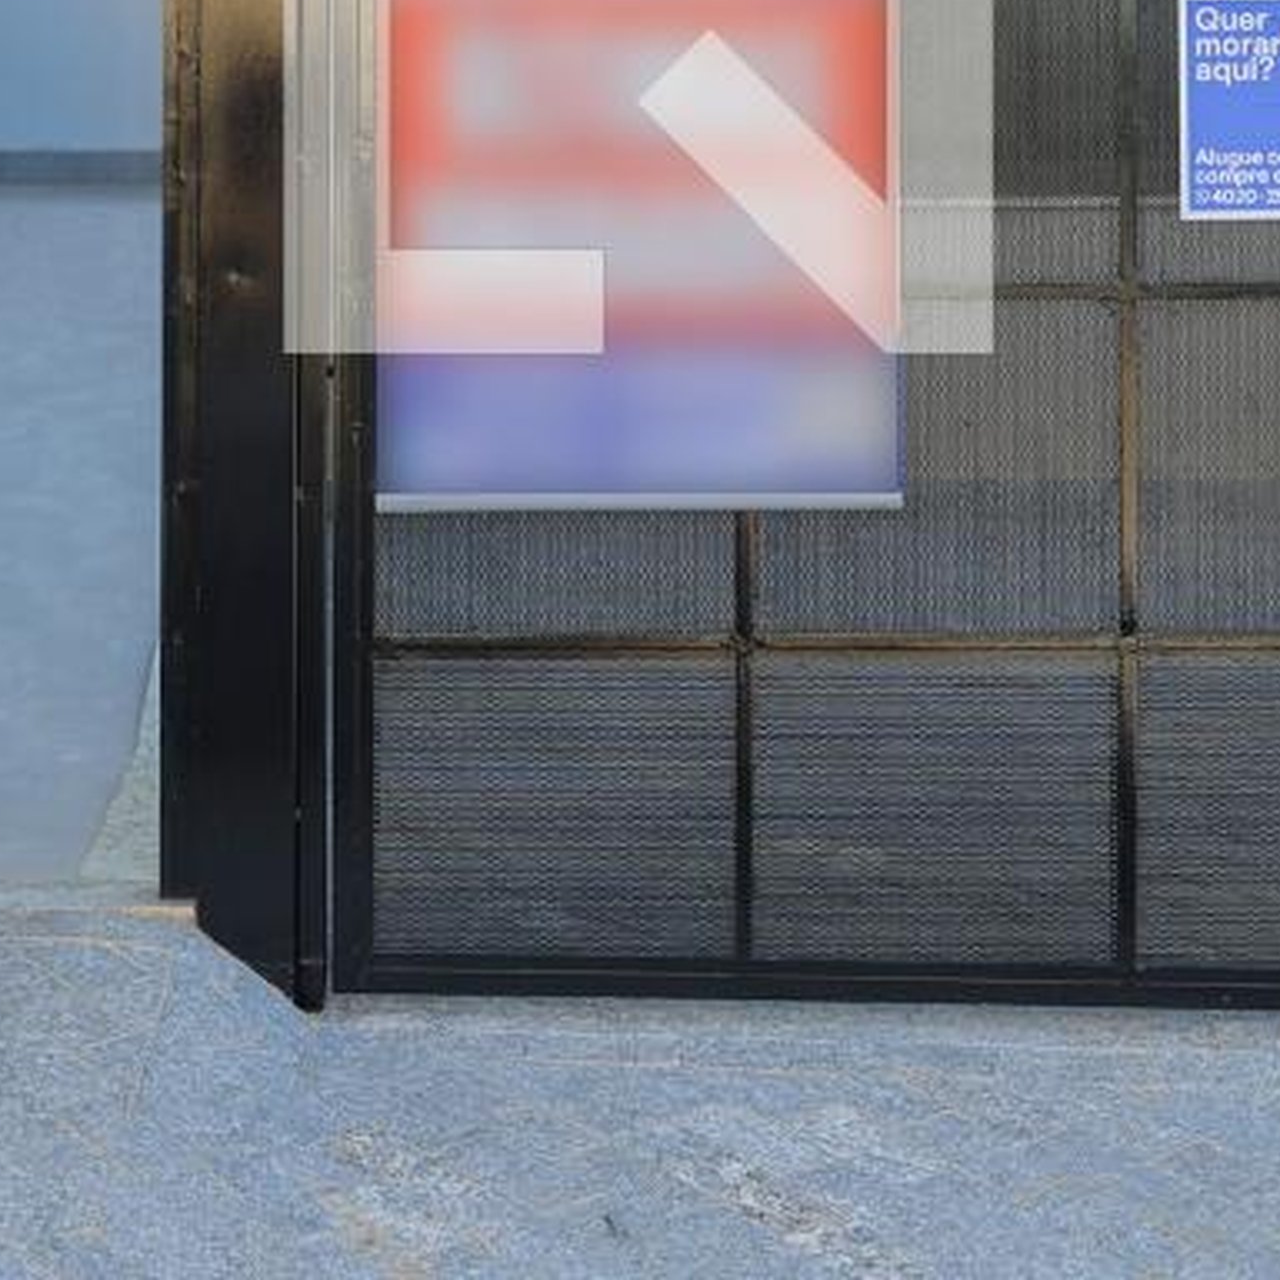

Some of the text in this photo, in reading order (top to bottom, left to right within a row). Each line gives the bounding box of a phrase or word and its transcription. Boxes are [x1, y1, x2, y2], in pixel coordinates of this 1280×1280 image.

[1195, 6, 1270, 32] Quer
[1195, 58, 1275, 86] aqui?
[1195, 148, 1264, 168] Alugue
[1195, 169, 1270, 187] compre
